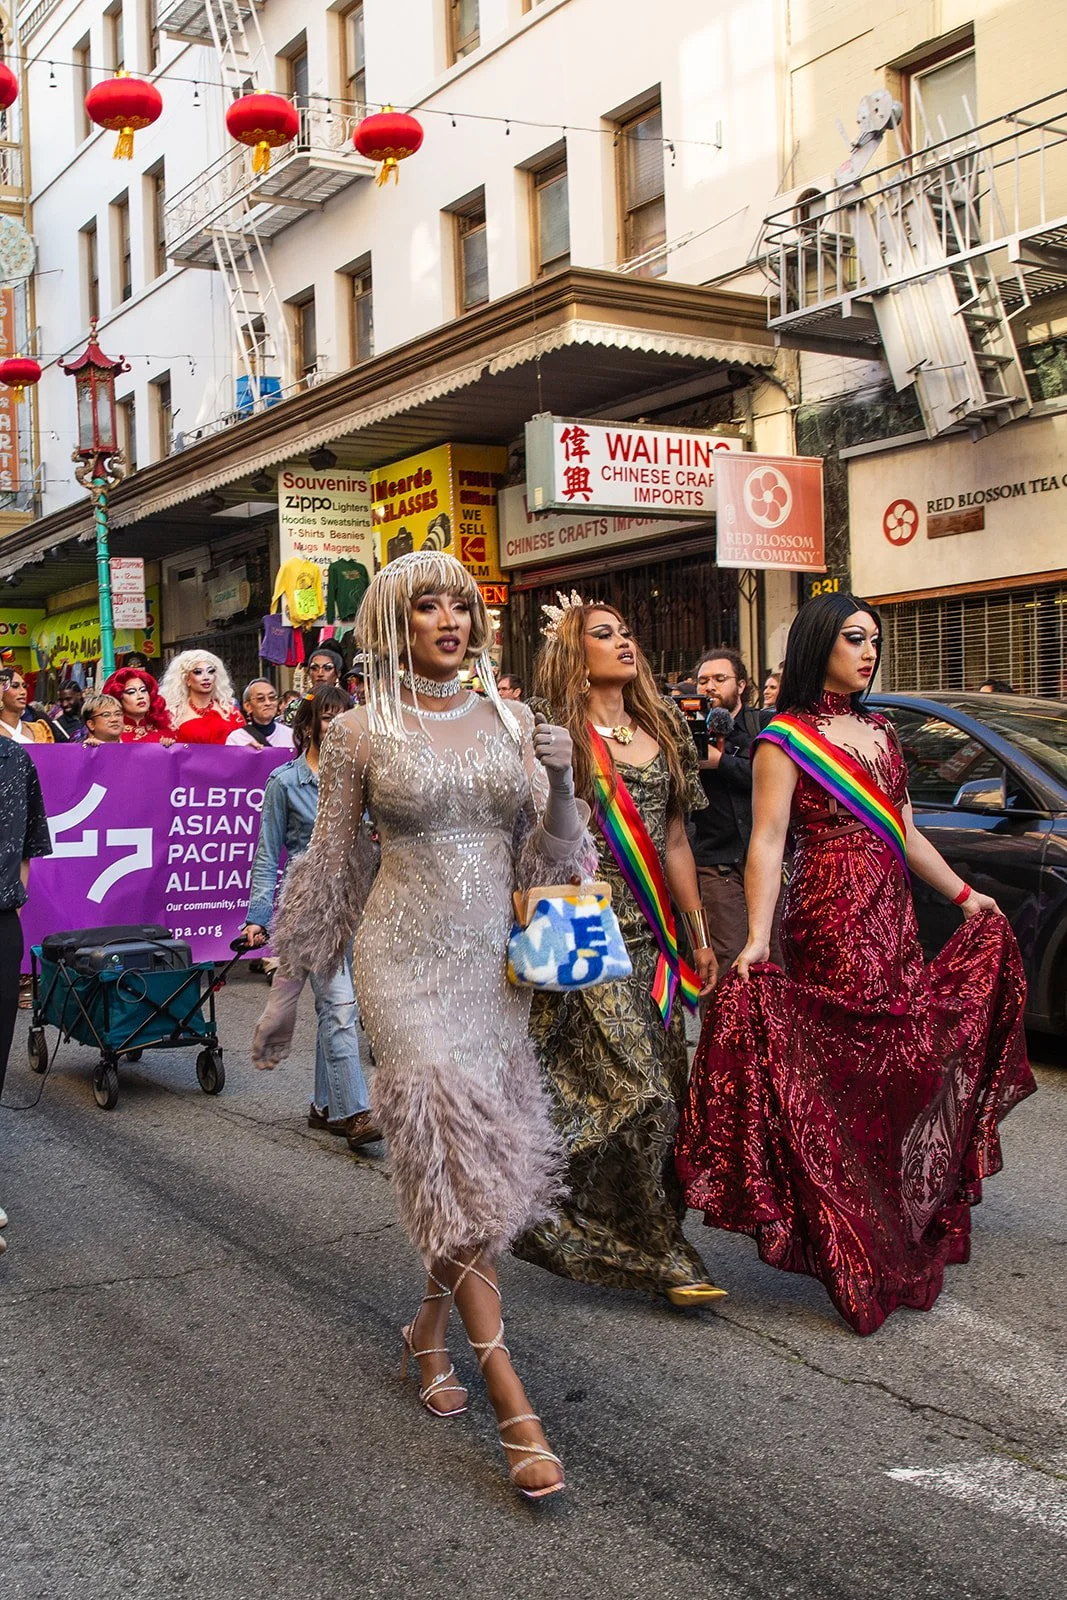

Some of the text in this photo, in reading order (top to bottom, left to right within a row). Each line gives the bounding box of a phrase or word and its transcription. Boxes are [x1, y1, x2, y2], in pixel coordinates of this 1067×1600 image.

[605, 433, 731, 468] WAI HIN
[559, 425, 593, 502] 偉興
[283, 472, 367, 492] Souvenirs
[601, 465, 670, 485] CHINESE
[285, 494, 369, 513] zippo Lighters
[634, 487, 704, 506] IMPORTS
[927, 497, 955, 514] RED
[958, 482, 1027, 508] BLOSSOM
[1028, 476, 1061, 494] TEA
[281, 514, 371, 528] Hoodies Sweatshirts
[462, 509, 482, 522] WE
[288, 528, 365, 540] T-Shirts Beanies
[459, 523, 487, 536] SELL
[506, 531, 554, 556] CHINESE
[558, 518, 608, 545] CRAFTS
[294, 542, 361, 554] Mugs Magnets
[726, 531, 815, 549] RED BLOSSOM
[726, 547, 749, 561] TEA
[170, 786, 265, 812] GLBTQ
[168, 815, 254, 837] ASIAN
[167, 842, 254, 865] PACIFI
[166, 902, 183, 912] Our
[183, 899, 235, 912] community,
